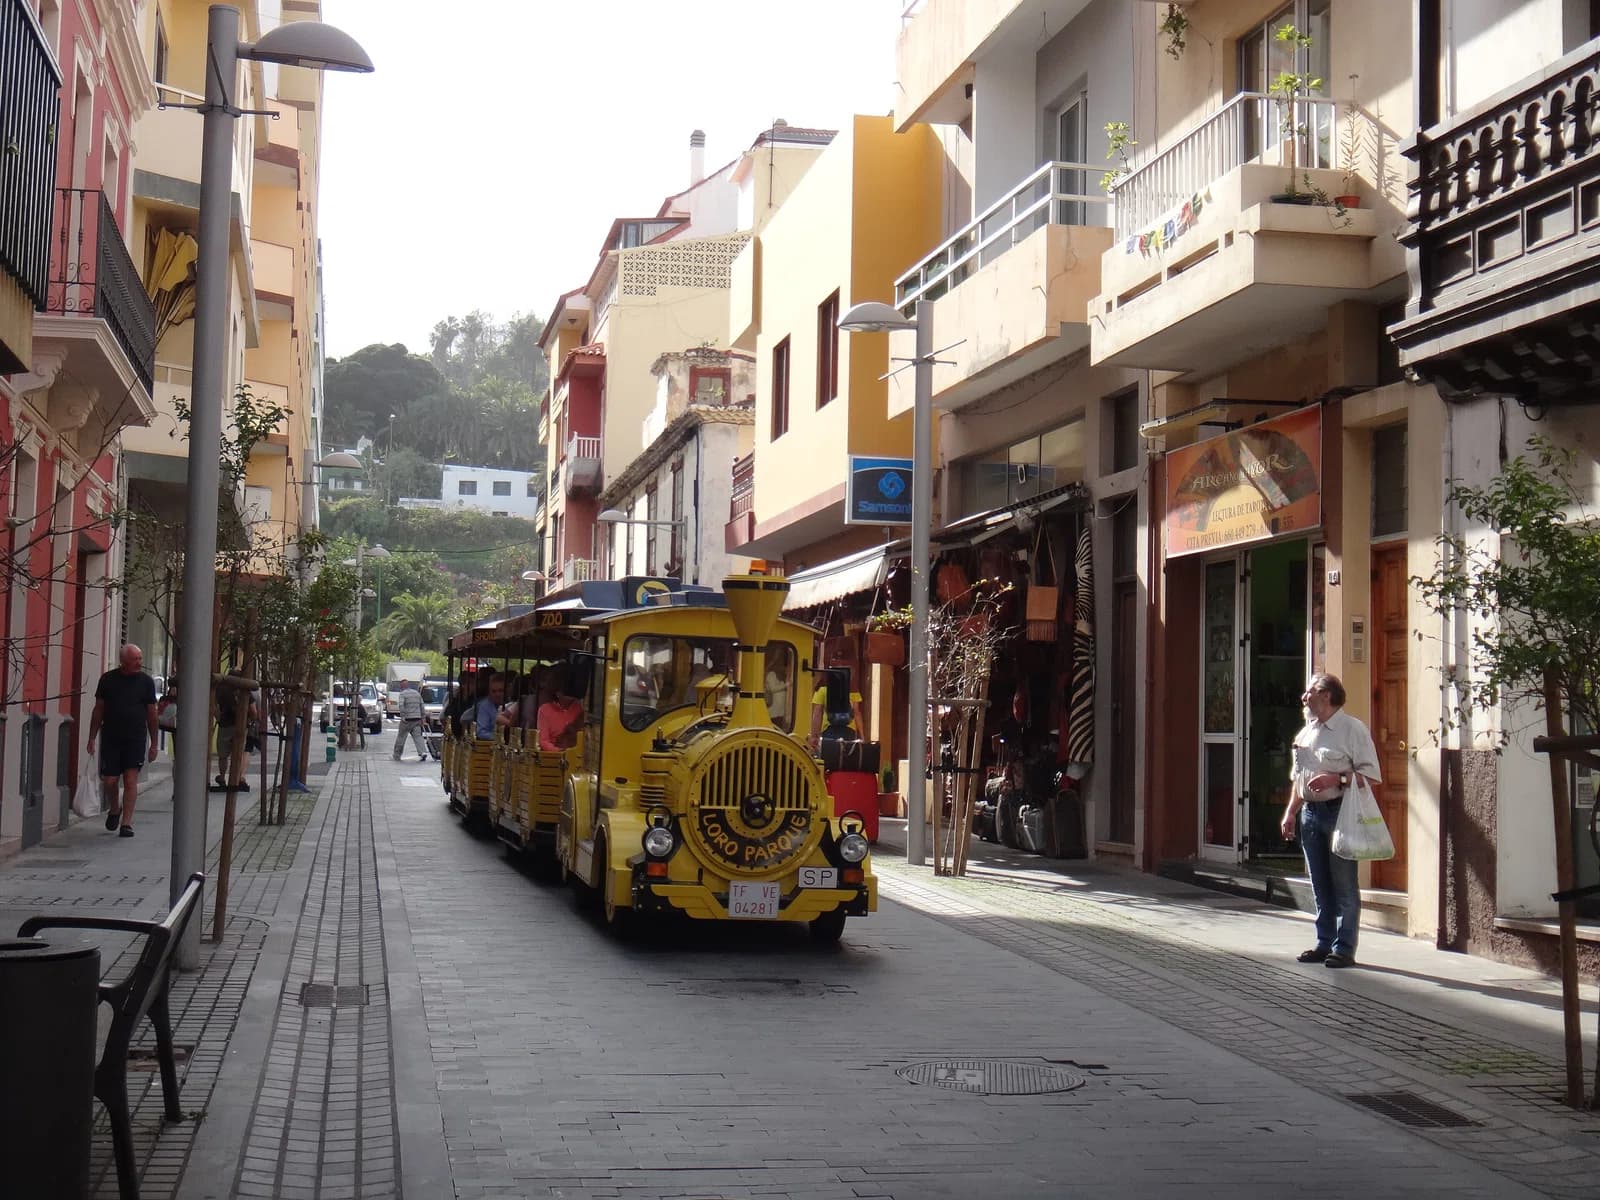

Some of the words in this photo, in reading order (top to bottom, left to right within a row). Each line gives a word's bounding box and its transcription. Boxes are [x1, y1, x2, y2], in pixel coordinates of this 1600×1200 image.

[858, 500, 912, 513] Samsoni
[1212, 506, 1236, 522] LECTURA
[1237, 504, 1245, 516] DE
[542, 612, 563, 626] ZOO
[703, 813, 739, 856] LORO
[744, 814, 807, 861] PARQUE
[803, 869, 833, 886] SP
[733, 885, 746, 897] TF
[762, 886, 777, 899] VE
[734, 902, 774, 914] 04281
